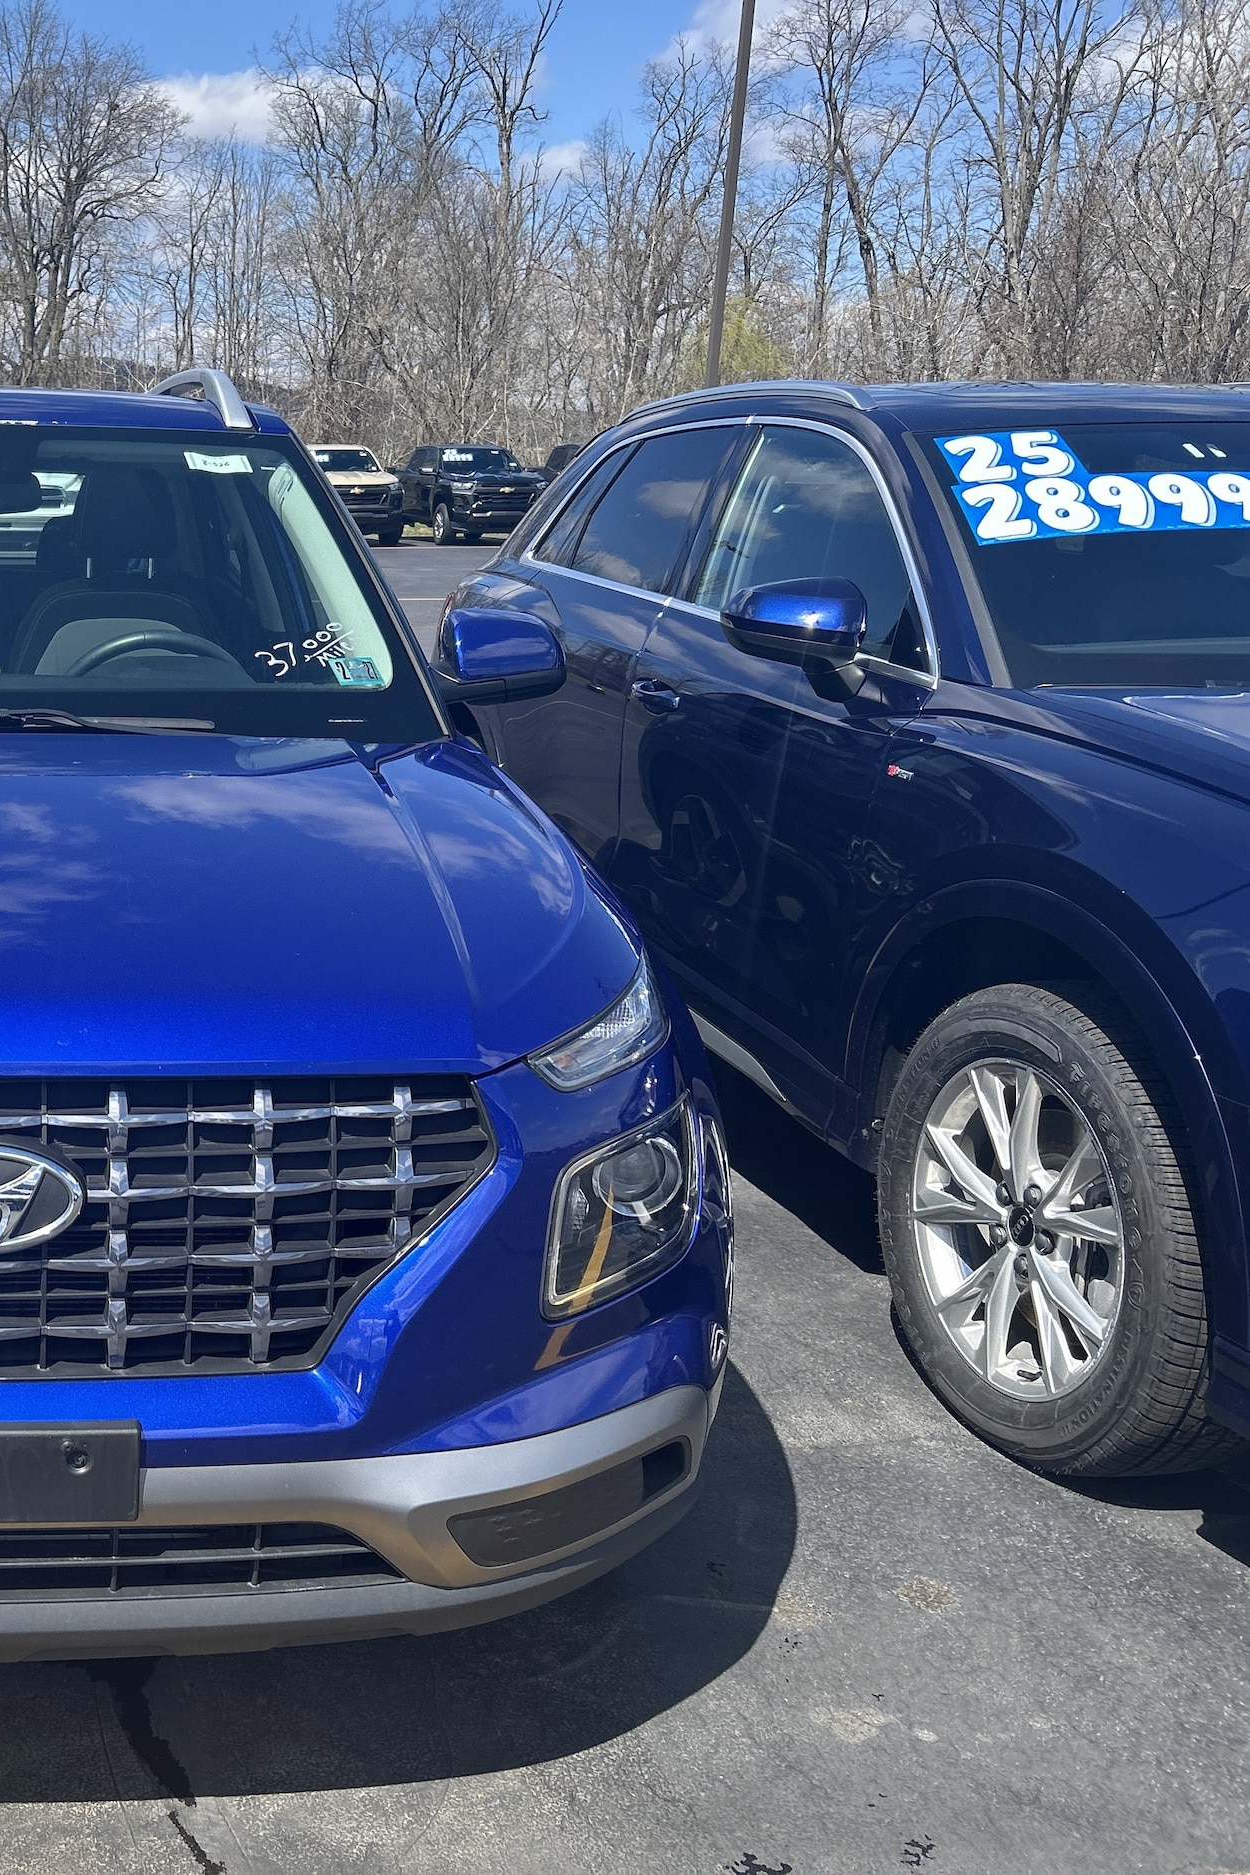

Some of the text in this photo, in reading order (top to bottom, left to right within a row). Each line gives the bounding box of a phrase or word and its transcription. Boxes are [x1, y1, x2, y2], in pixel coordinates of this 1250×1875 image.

[943, 431, 1075, 483] 25
[961, 473, 1250, 541] 28999
[316, 636, 355, 668] Mile
